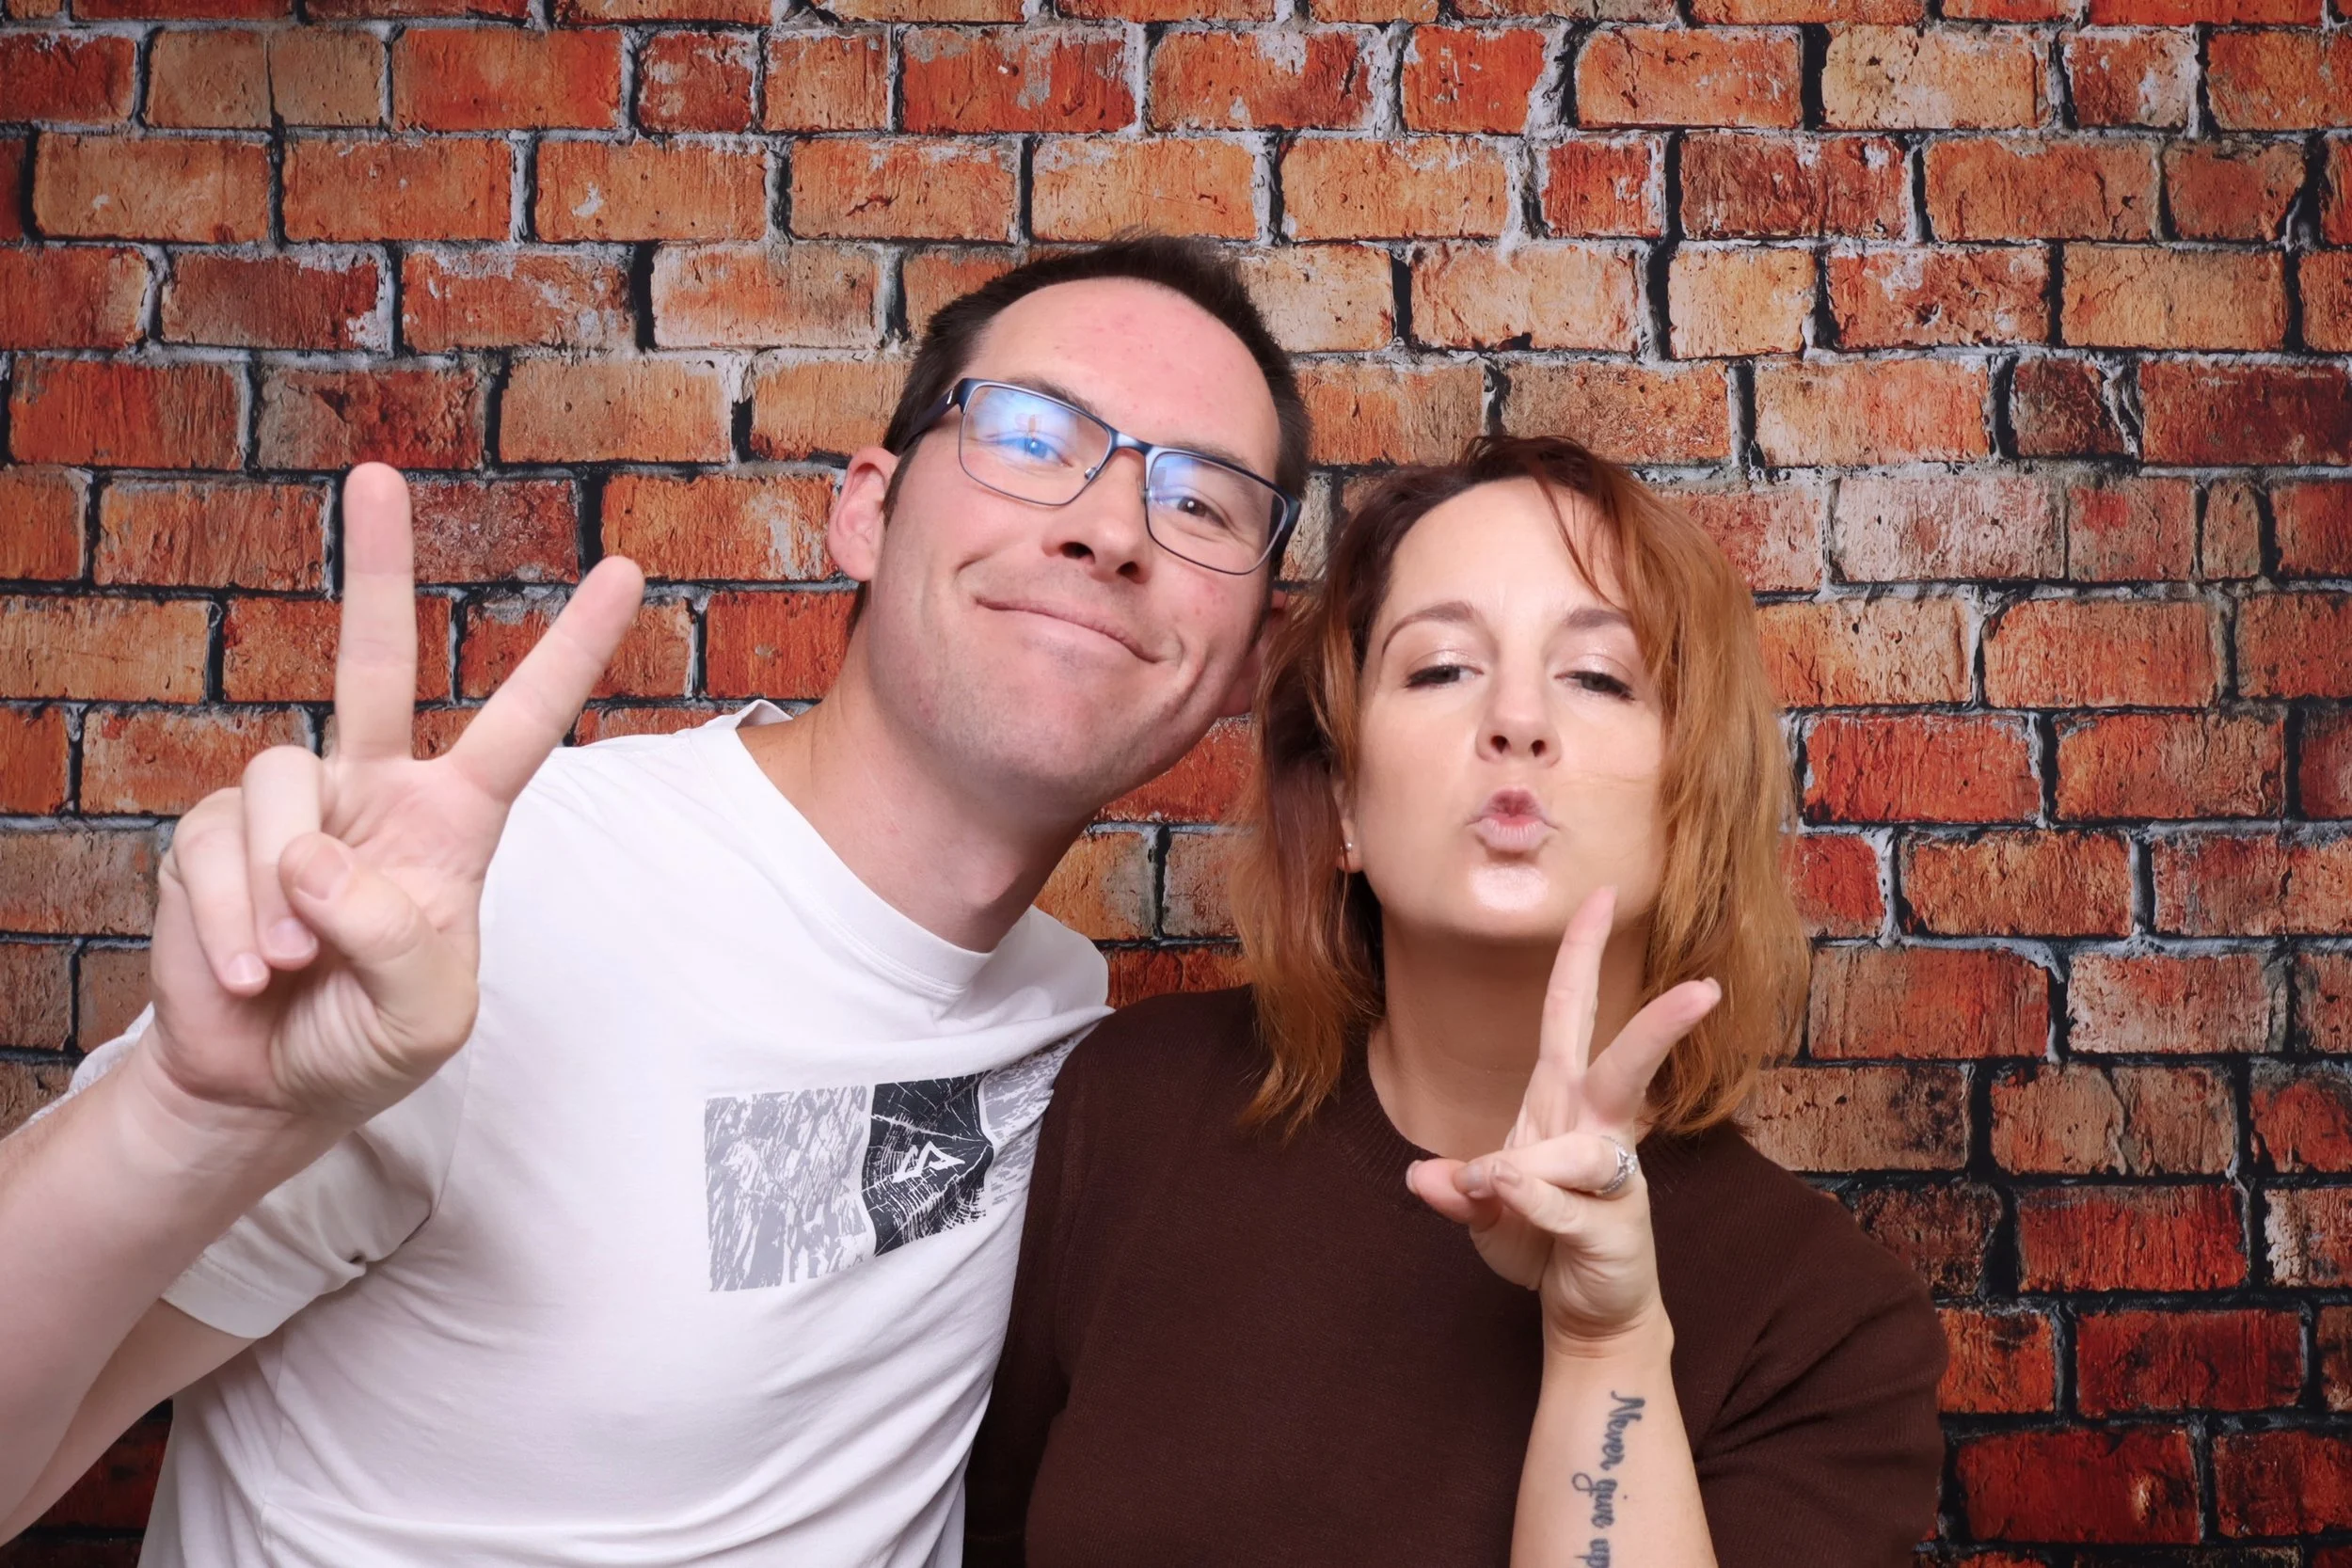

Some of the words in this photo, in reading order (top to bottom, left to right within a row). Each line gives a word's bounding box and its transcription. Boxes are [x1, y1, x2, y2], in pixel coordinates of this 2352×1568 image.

[1599, 1389, 1645, 1471] Never
[1571, 1472, 1627, 1529] give
[1574, 1538, 1611, 1568] up
